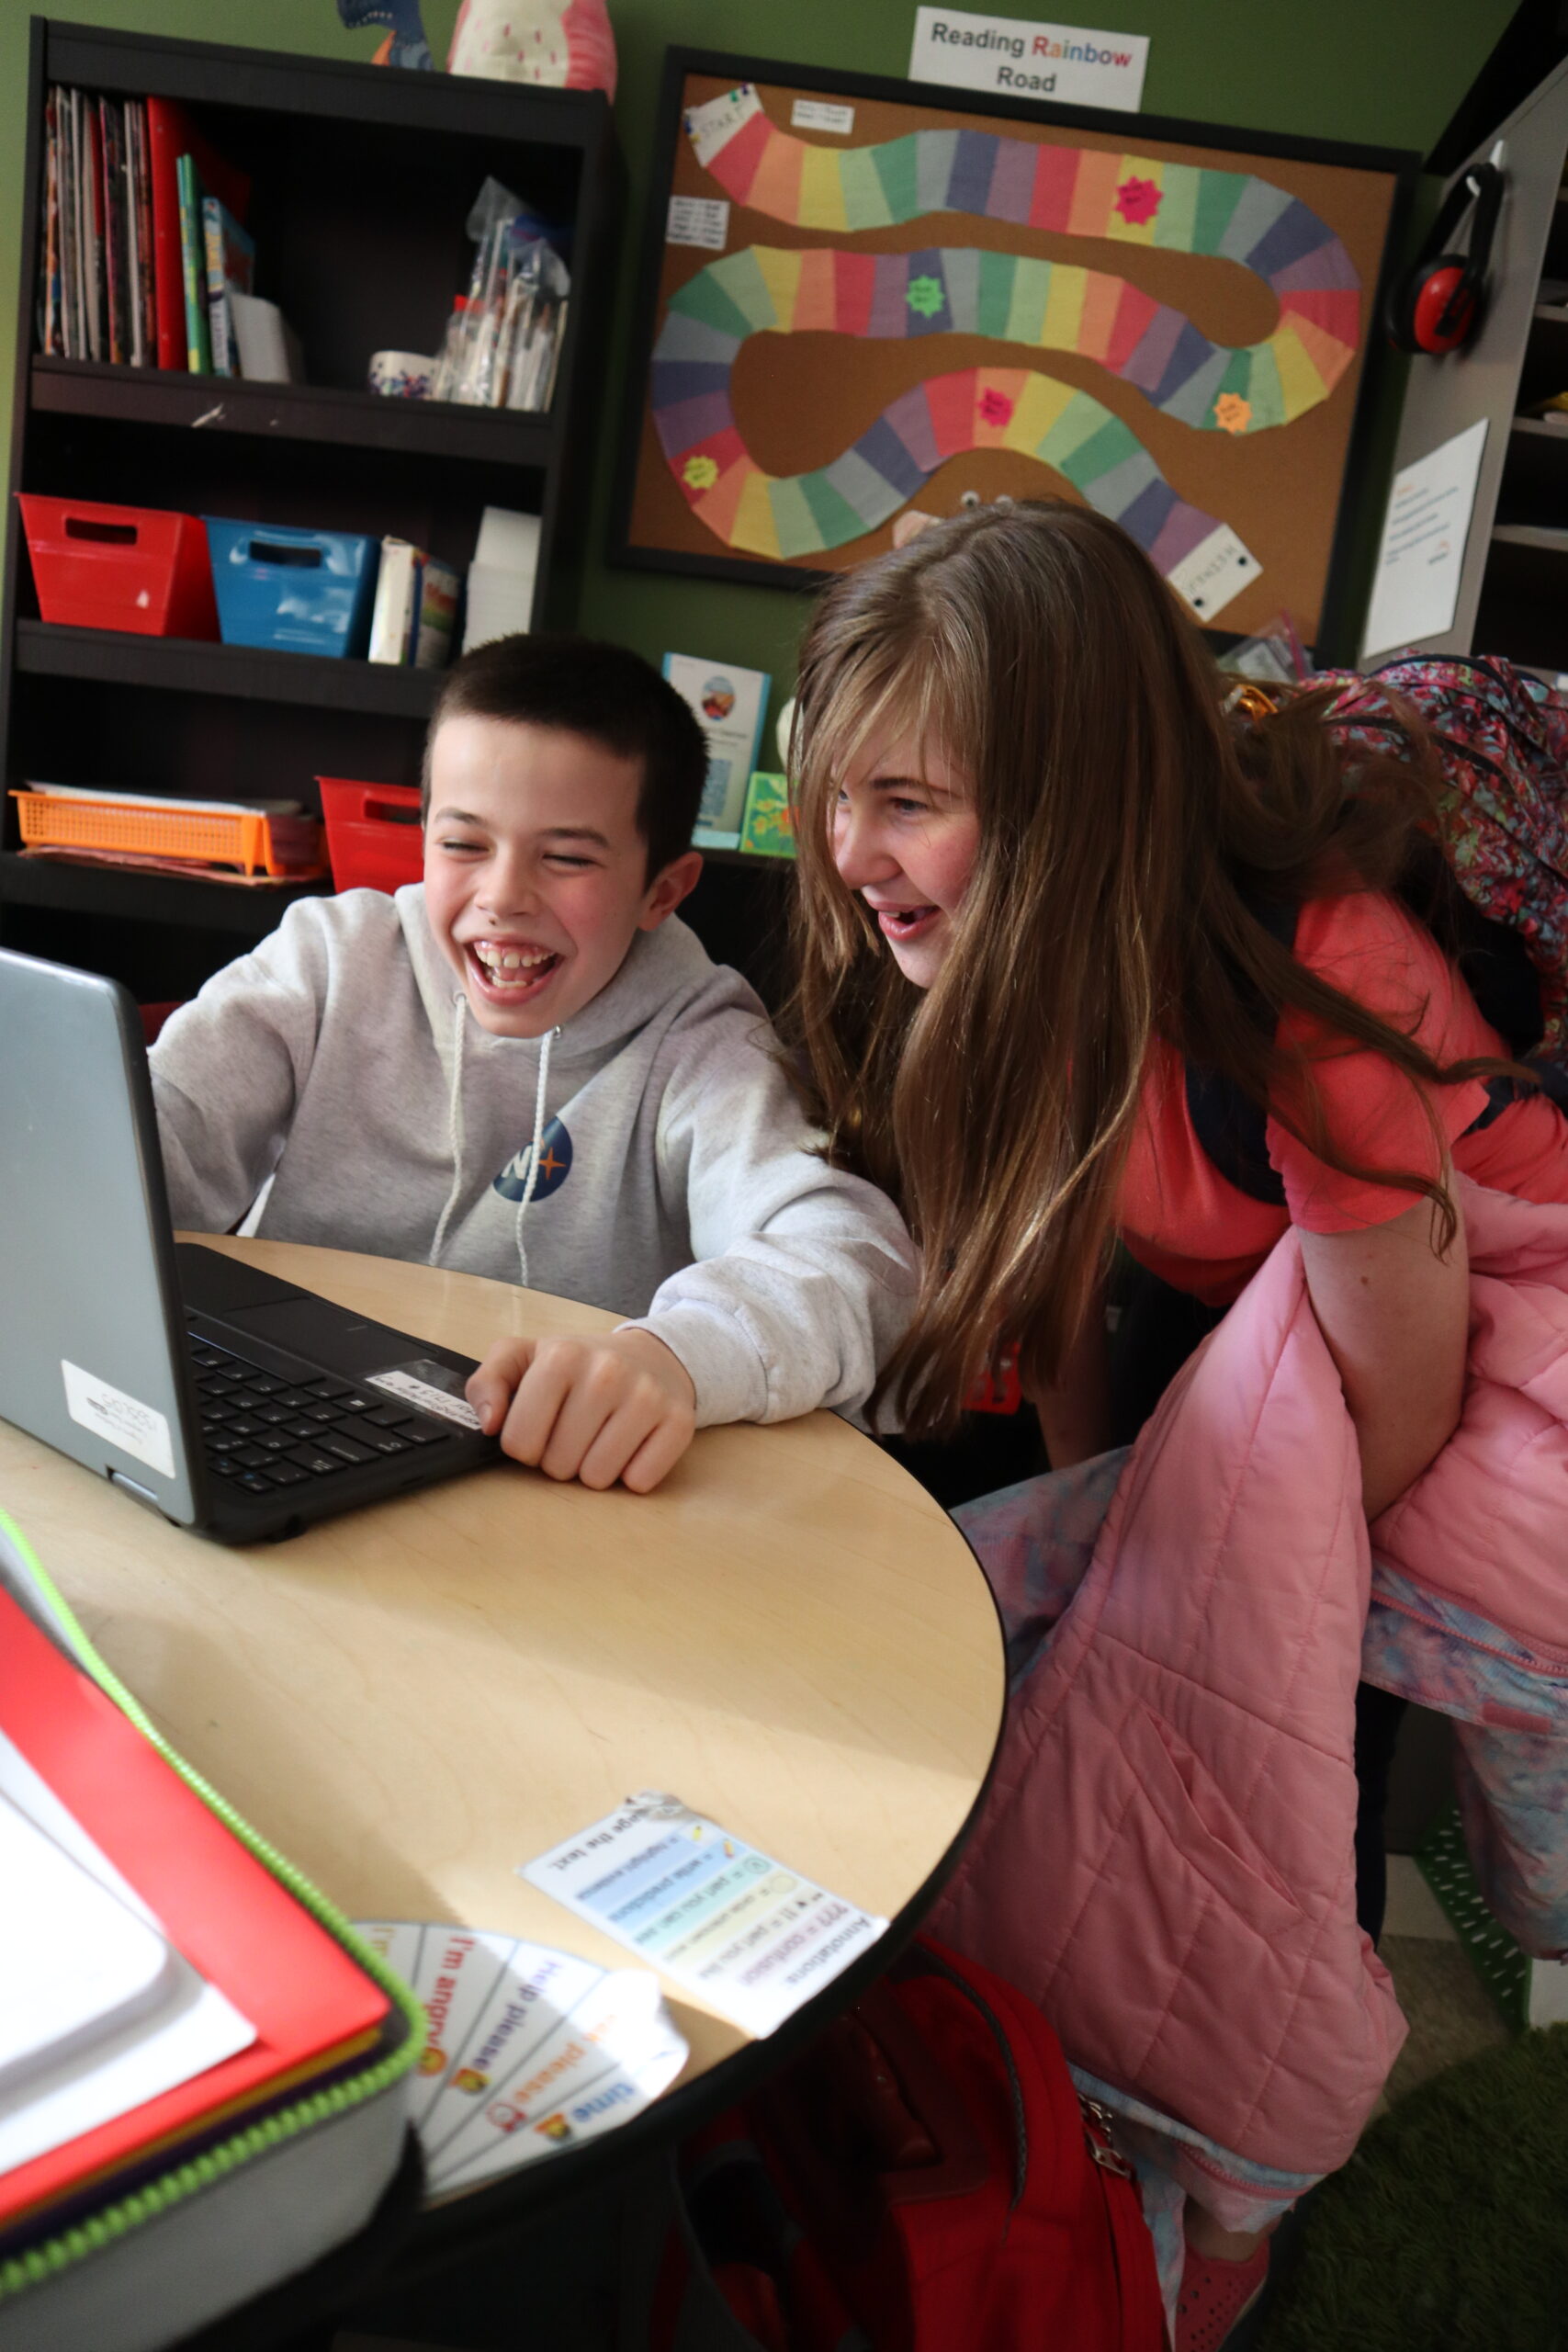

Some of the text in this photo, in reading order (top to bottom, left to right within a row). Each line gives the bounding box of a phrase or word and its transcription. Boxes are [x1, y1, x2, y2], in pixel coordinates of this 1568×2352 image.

[931, 21, 1133, 68] Reading Rainbow
[996, 65, 1058, 93] Road
[547, 1848, 589, 1871] text.
[583, 1832, 615, 1850] the
[441, 1936, 475, 1970] I'm
[738, 1932, 807, 1987] confusion
[471, 1959, 563, 2070] Help please
[513, 2041, 588, 2104] please
[571, 2081, 636, 2123] time
